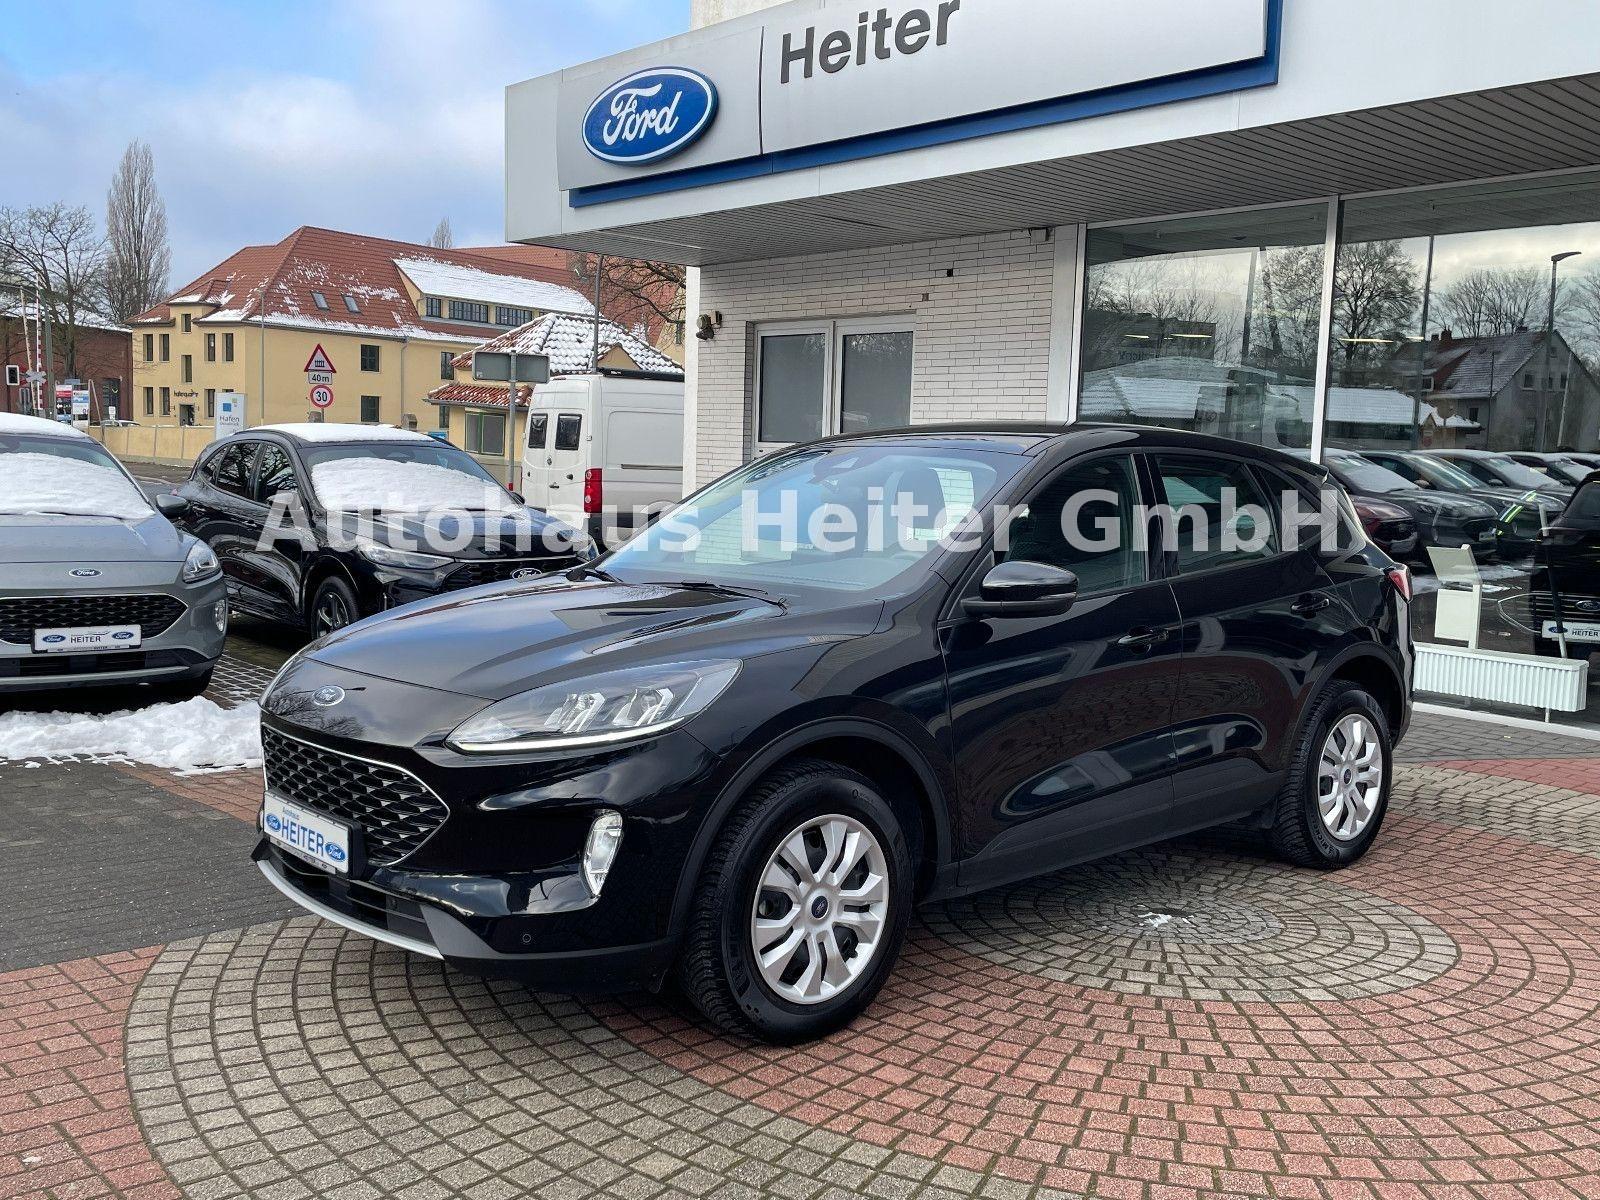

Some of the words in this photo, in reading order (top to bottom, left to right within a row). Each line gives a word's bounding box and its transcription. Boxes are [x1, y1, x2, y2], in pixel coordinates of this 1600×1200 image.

[781, 0, 960, 84] Heiter
[603, 82, 682, 146] Ford
[315, 390, 328, 402] 30
[219, 414, 240, 423] Hafen
[70, 635, 101, 644] HEITER
[281, 816, 324, 857] HEITER
